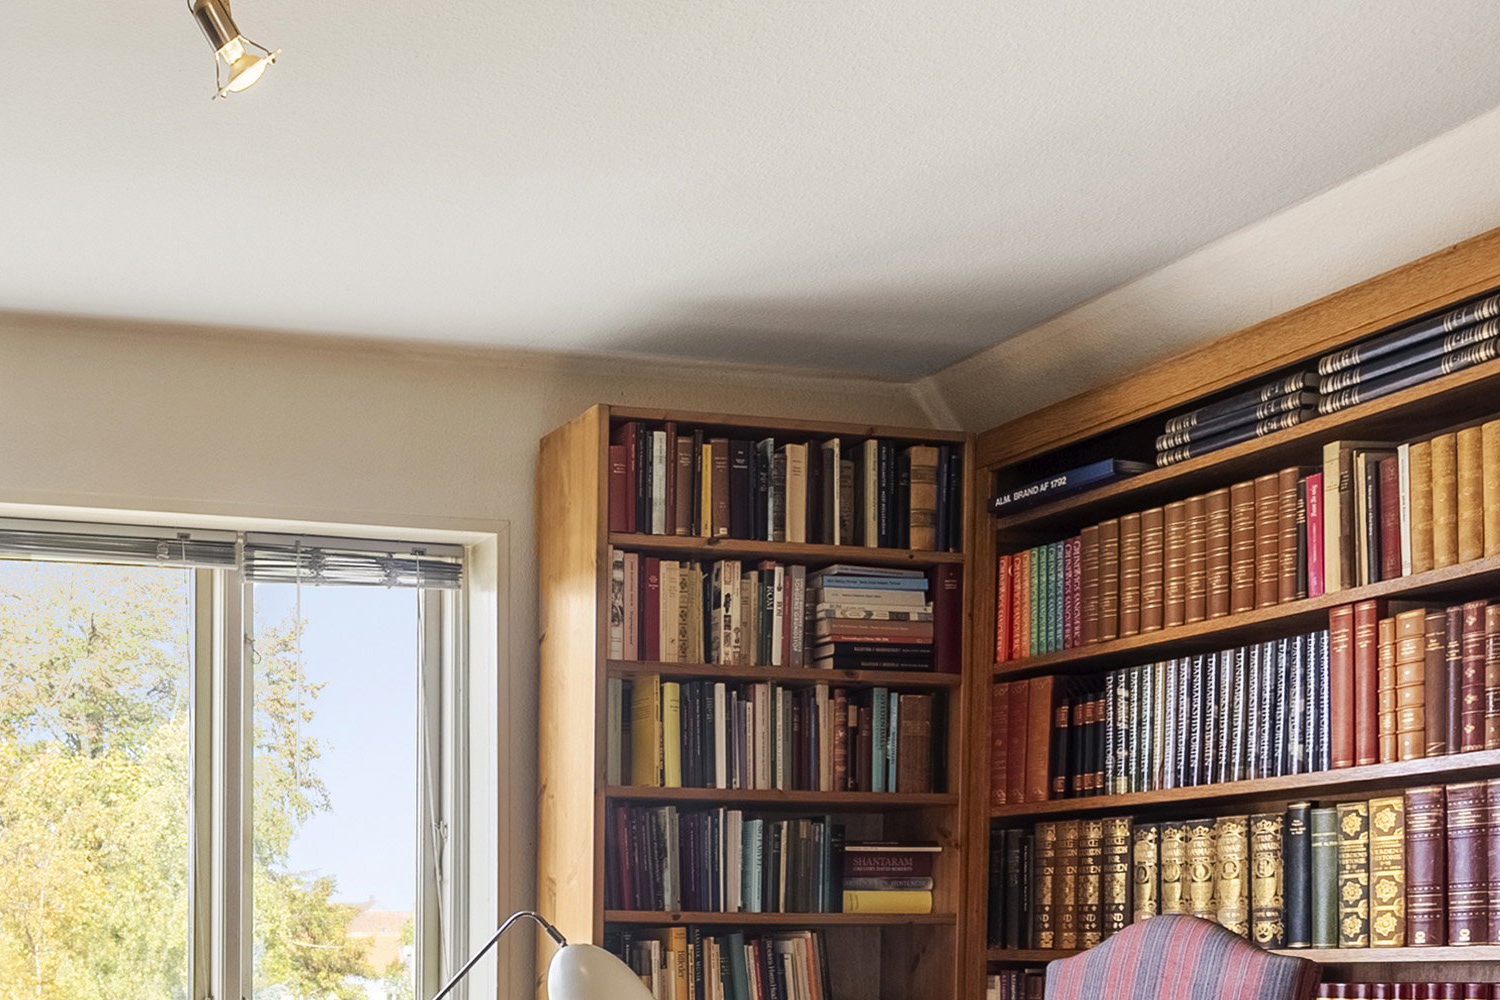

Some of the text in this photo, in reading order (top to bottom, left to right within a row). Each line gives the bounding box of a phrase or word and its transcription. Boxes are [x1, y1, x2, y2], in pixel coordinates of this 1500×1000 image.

[1013, 486, 1039, 501] BRAND
[1039, 481, 1049, 492] AF
[1050, 476, 1067, 488] 1792
[853, 857, 914, 866] SHANTARAM
[677, 950, 685, 979] Billeder
